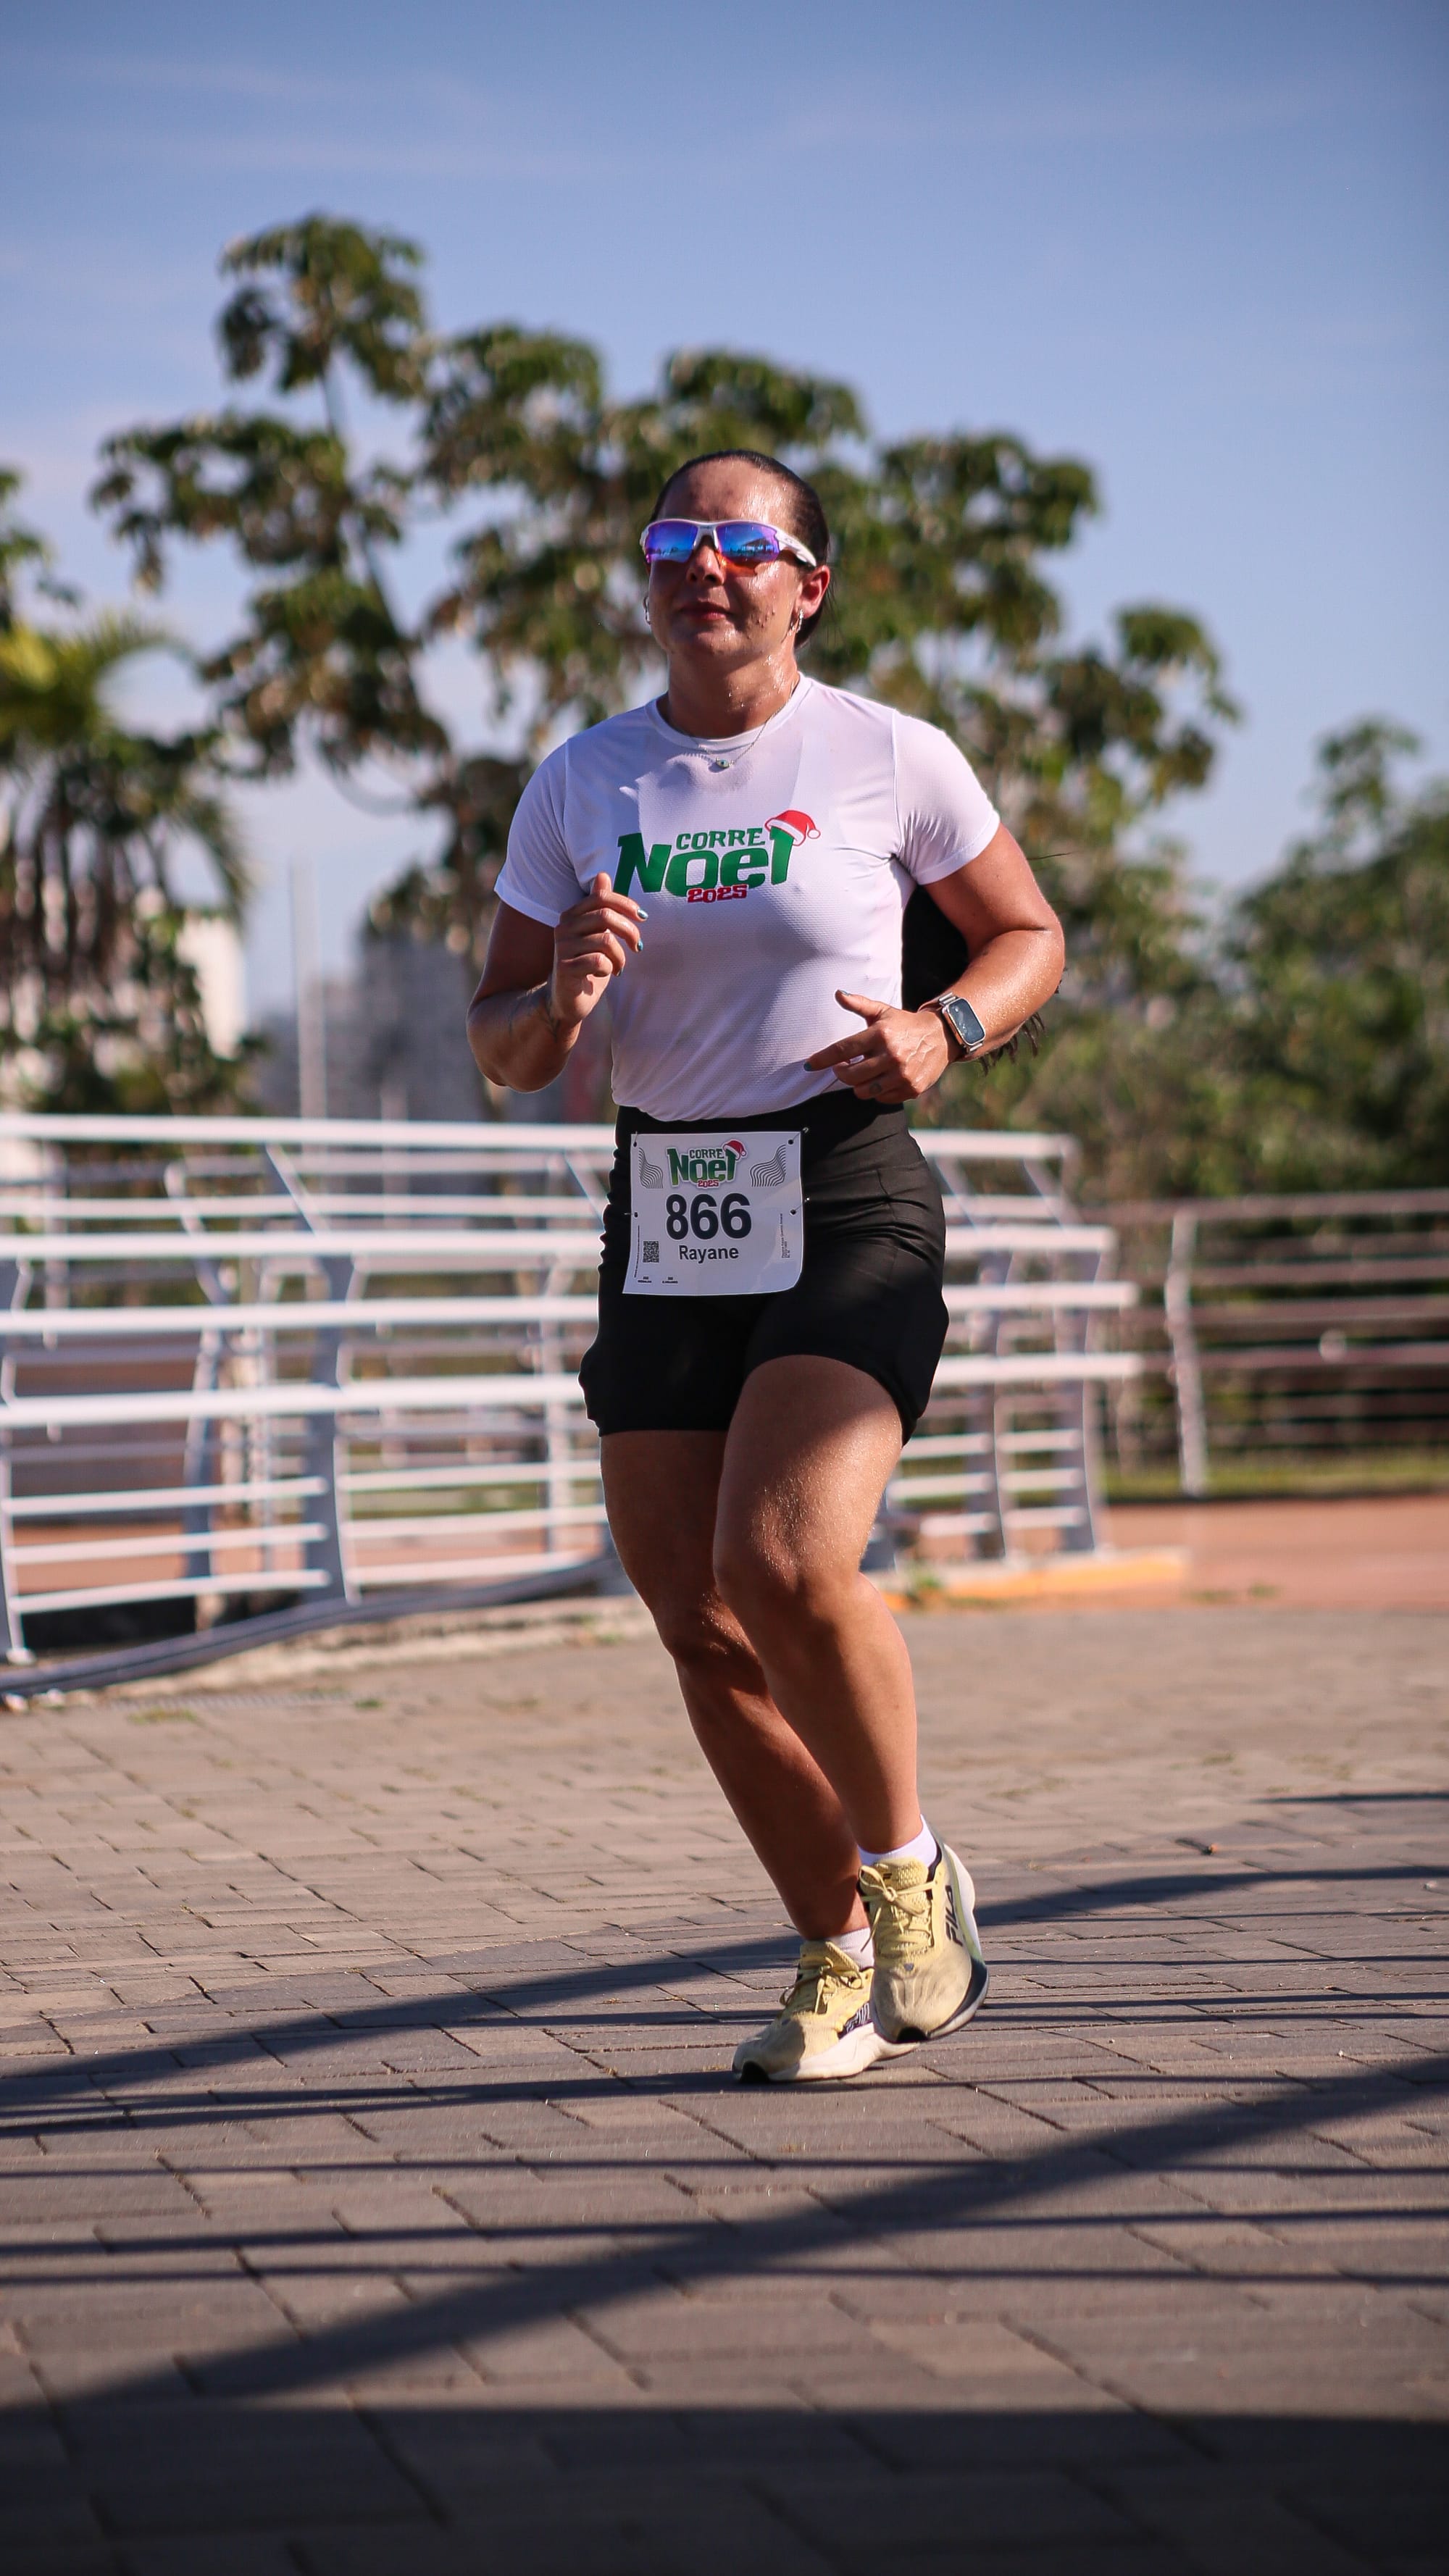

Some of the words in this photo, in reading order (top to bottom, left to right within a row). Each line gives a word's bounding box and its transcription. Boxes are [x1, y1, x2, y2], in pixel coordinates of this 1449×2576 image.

[676, 828, 765, 850] CORRE
[613, 826, 794, 897] Noel
[688, 885, 748, 903] 2025
[690, 1149, 724, 1158] CORRE
[666, 1193, 751, 1240] 866
[679, 1245, 739, 1263] Rayane
[945, 1885, 963, 1947] FILA
